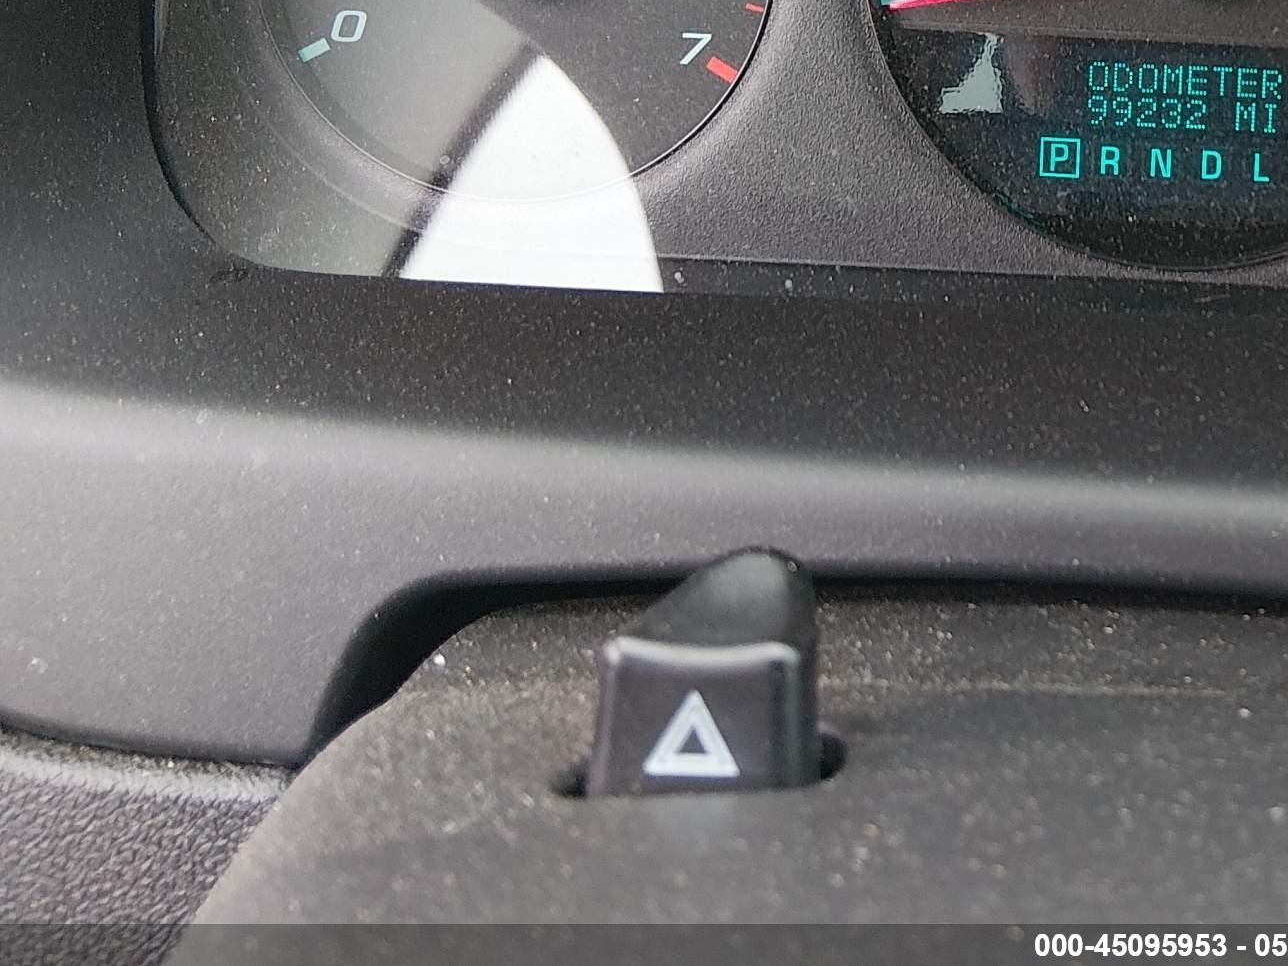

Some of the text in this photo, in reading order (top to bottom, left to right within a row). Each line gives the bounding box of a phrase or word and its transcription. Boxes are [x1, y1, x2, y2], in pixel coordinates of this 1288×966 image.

[330, 10, 368, 43] 0
[679, 32, 712, 65] 7
[1088, 61, 1283, 97] ODOMETER
[1087, 95, 1278, 133] 99232 MI
[1049, 142, 1270, 182] P R N D L
